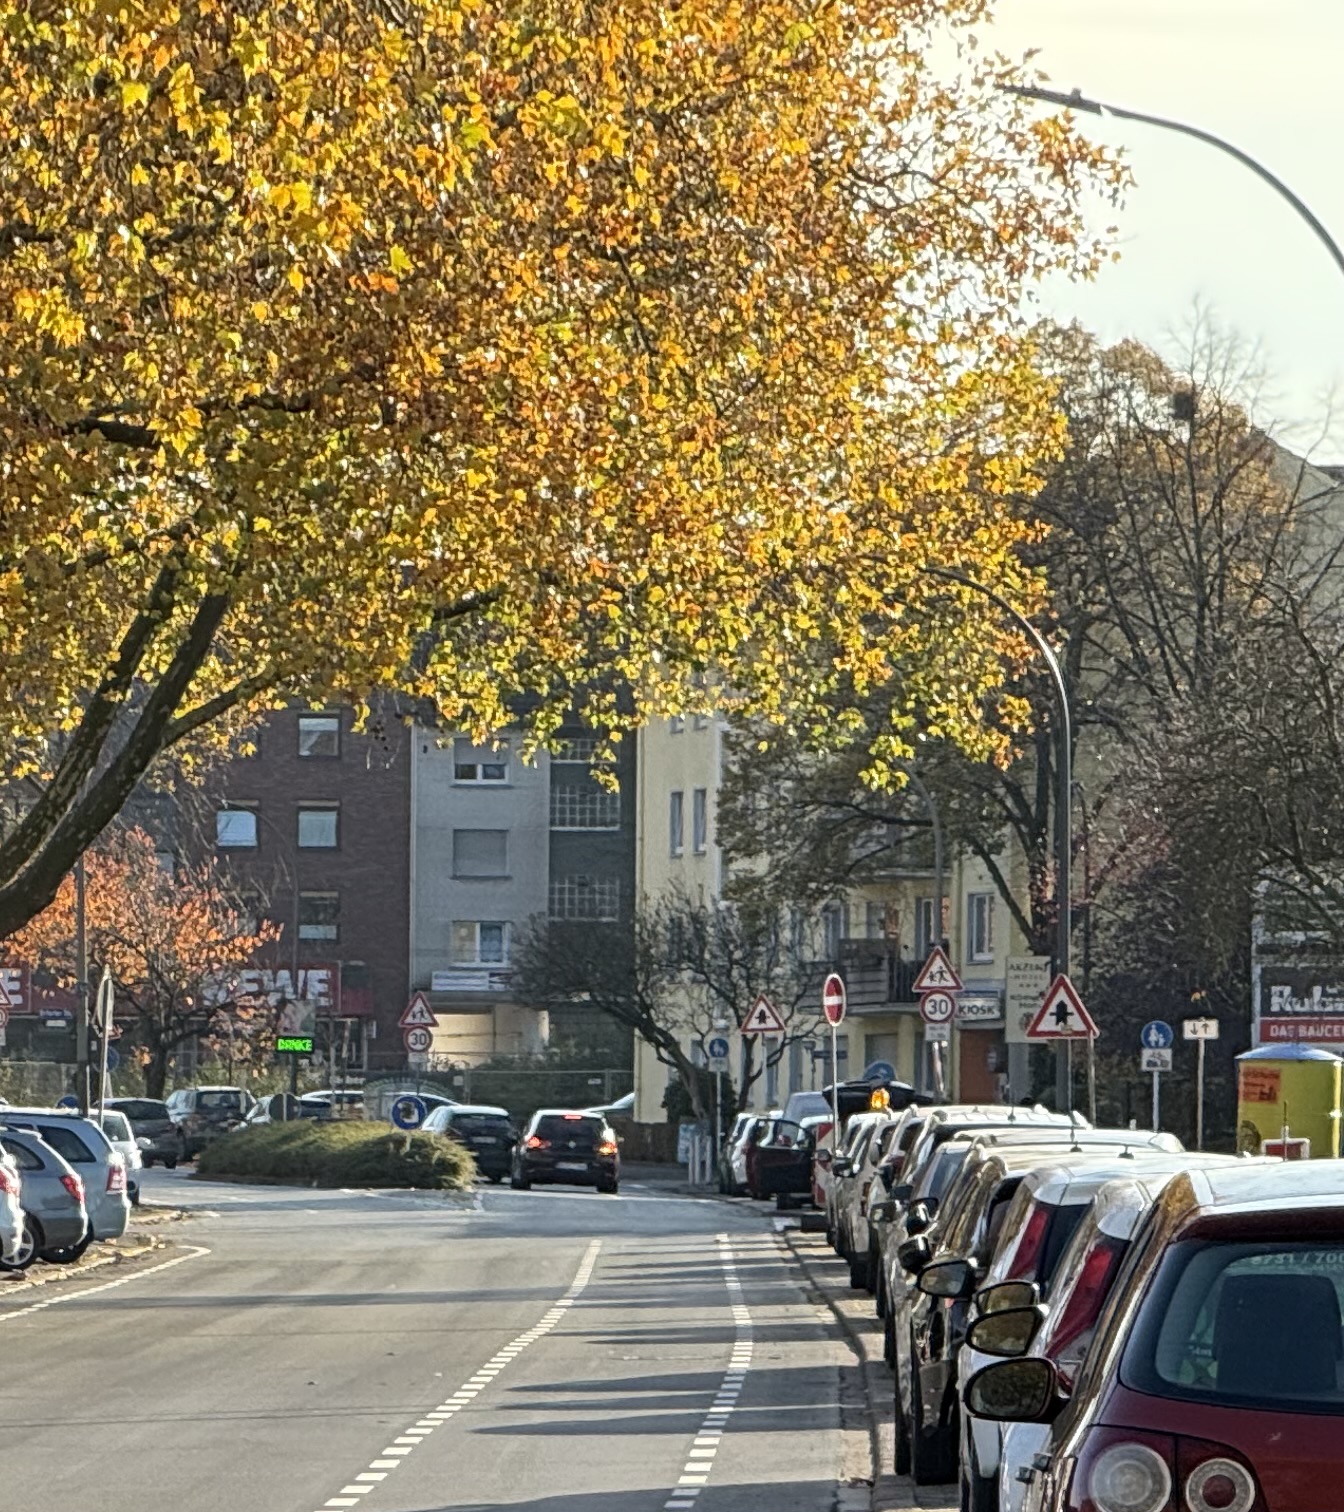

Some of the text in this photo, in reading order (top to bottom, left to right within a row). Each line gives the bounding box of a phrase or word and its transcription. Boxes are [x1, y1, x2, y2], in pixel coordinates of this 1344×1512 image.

[928, 999, 948, 1015] 30
[958, 1004, 995, 1015] KIOSK
[1299, 1025, 1344, 1037] BAUCE
[411, 1033, 427, 1046] 30
